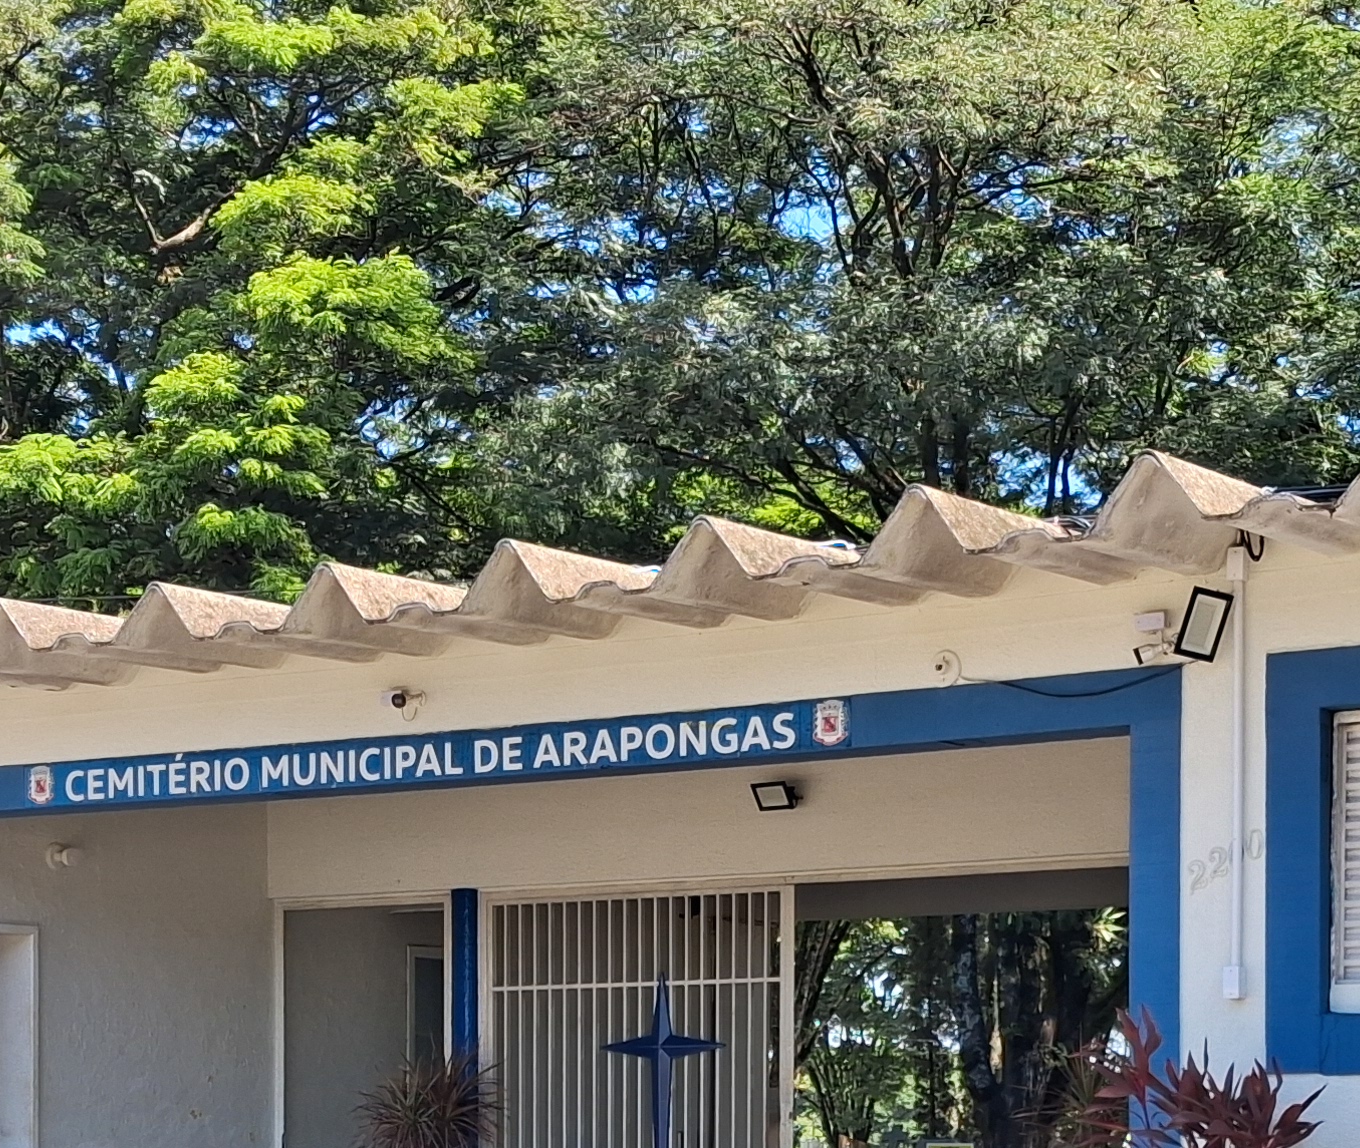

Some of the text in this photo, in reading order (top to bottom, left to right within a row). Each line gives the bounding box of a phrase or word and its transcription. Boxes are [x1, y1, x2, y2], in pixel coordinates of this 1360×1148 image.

[64, 712, 797, 802] CEMITÉRIO MUNICIPAL DE ARAPONGAS
